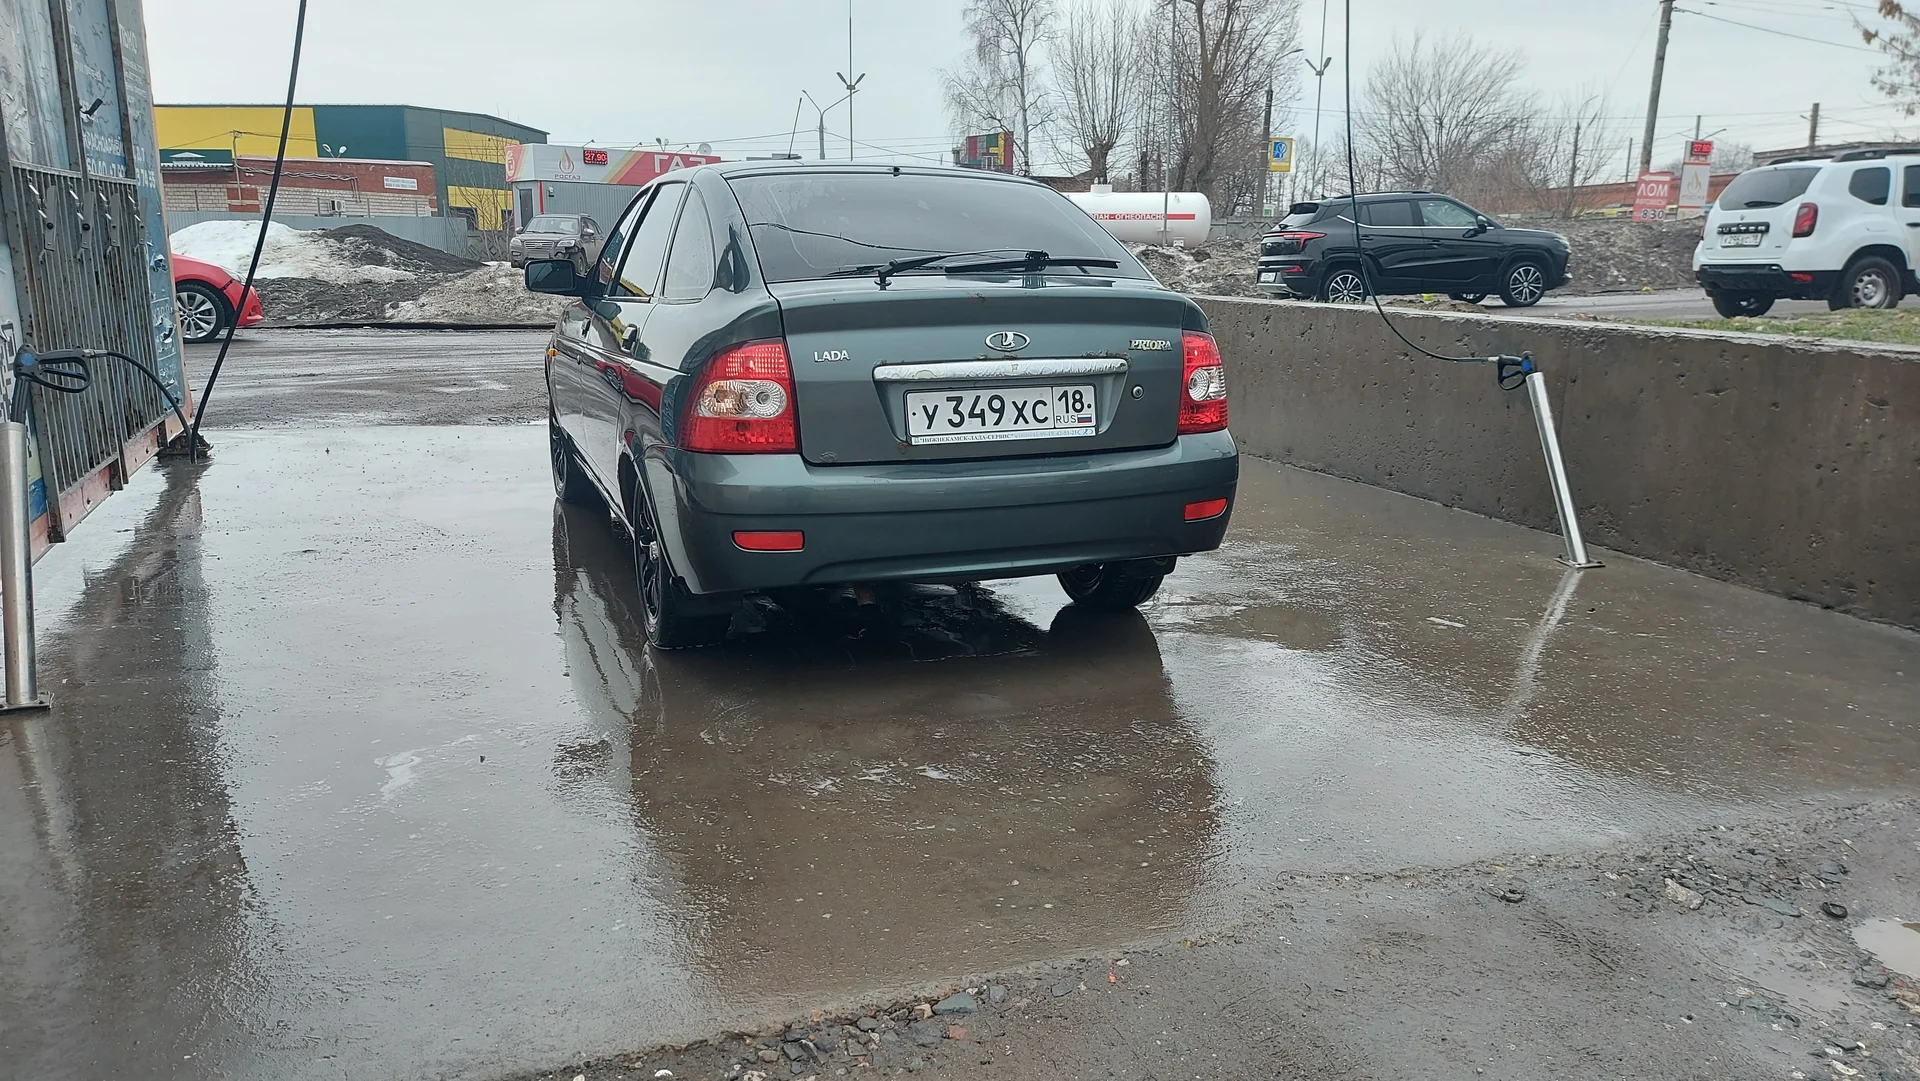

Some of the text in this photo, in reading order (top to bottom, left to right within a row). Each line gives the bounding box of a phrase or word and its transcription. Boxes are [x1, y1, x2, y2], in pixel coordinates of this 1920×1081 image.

[585, 152, 607, 162] 27.90
[654, 154, 707, 173] ГАЗ
[1637, 183, 1669, 197] ЛОМ
[1129, 339, 1173, 351] PRIORA
[813, 349, 851, 362] LADA
[1057, 389, 1085, 414] 18
[1055, 414, 1077, 424] RUS
